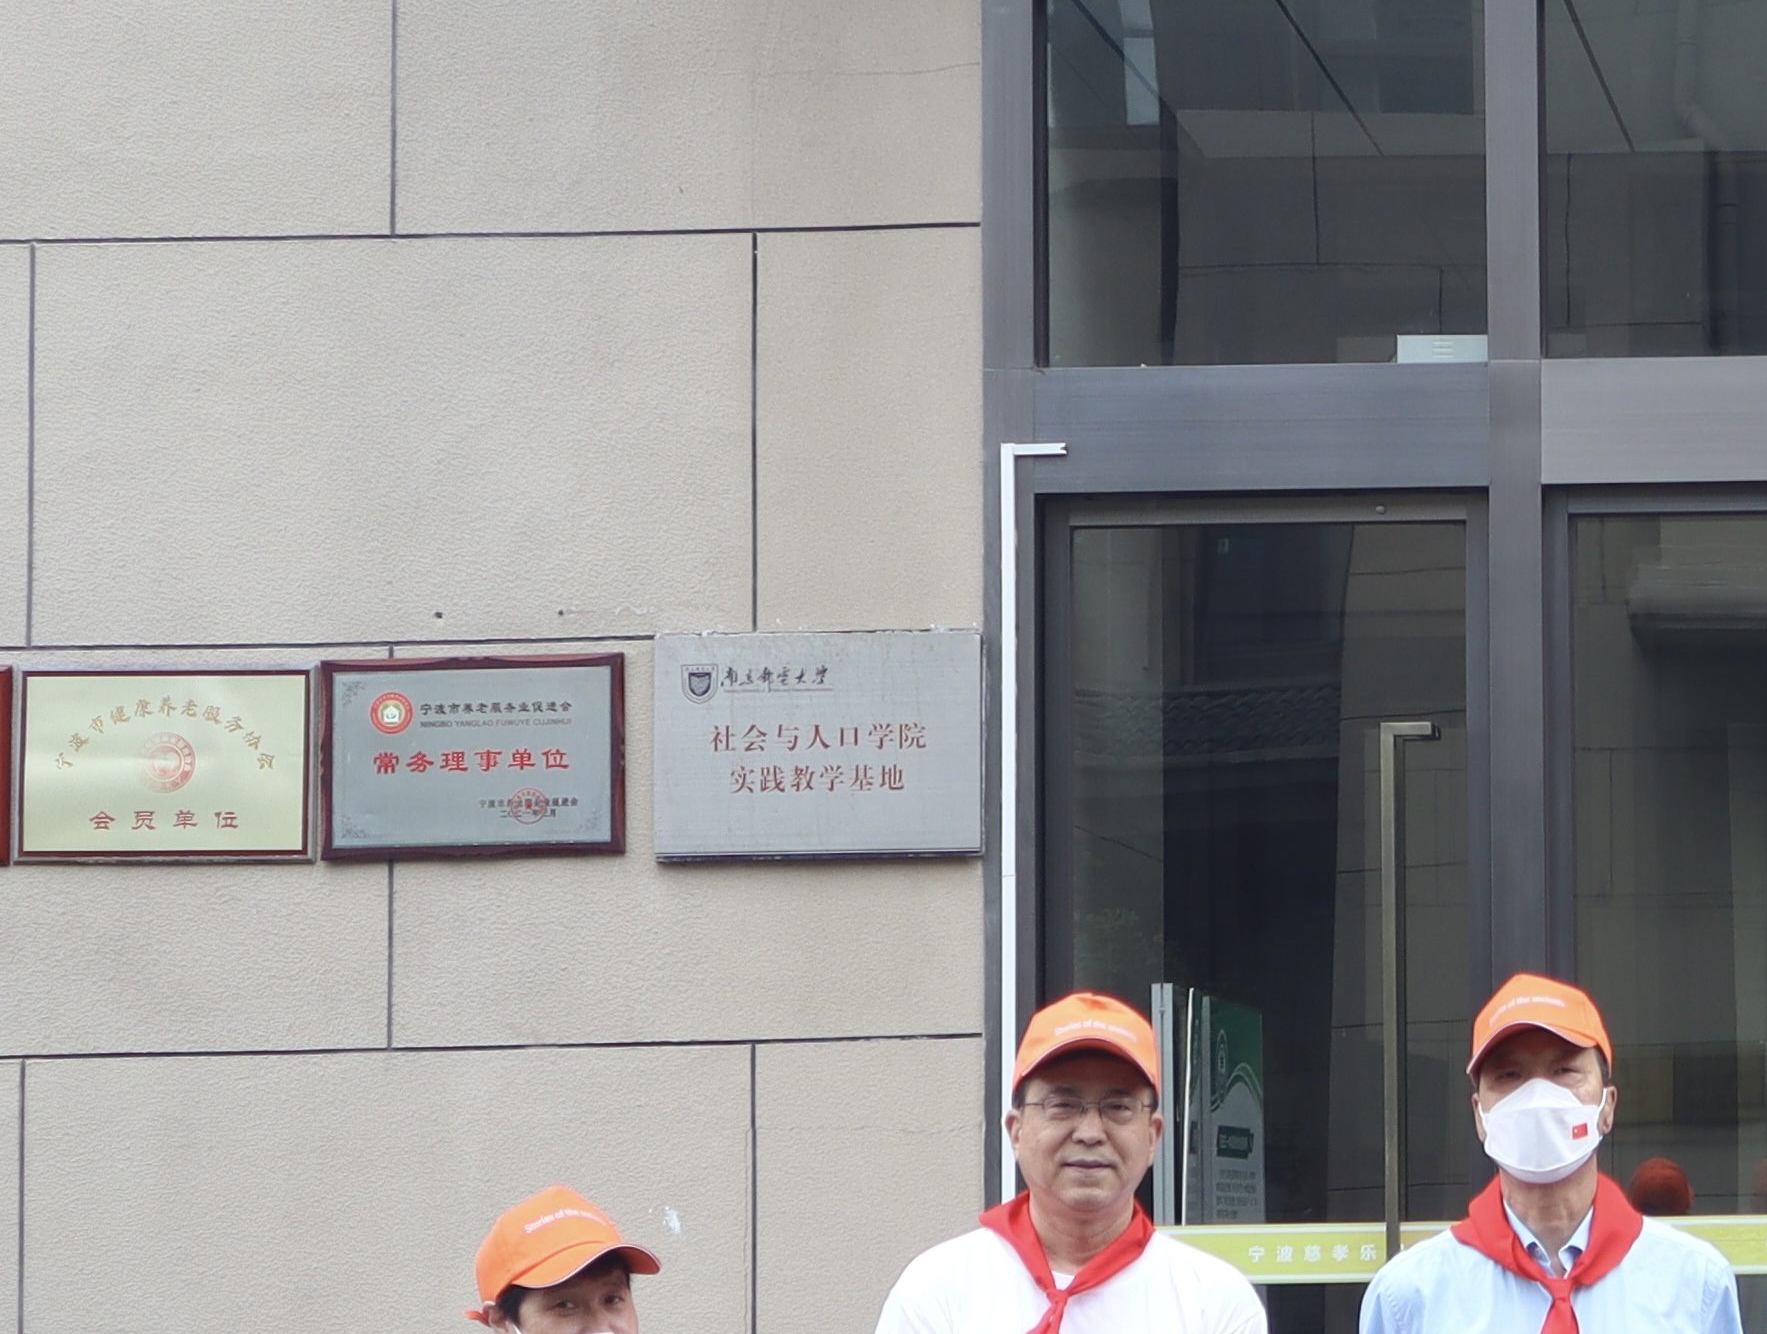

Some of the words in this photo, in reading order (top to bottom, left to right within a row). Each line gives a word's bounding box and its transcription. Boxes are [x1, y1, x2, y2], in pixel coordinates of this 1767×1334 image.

[420, 700, 573, 716] 宁波市养老服务业促进会
[710, 722, 928, 753] 社会与人口学院
[373, 748, 571, 775] 常务理事单位
[730, 764, 906, 794] 实践教学基地
[89, 809, 240, 832] 会员单位
[524, 1214, 555, 1234] Stories
[1248, 1244, 1405, 1263] 宁波慈孝乐
